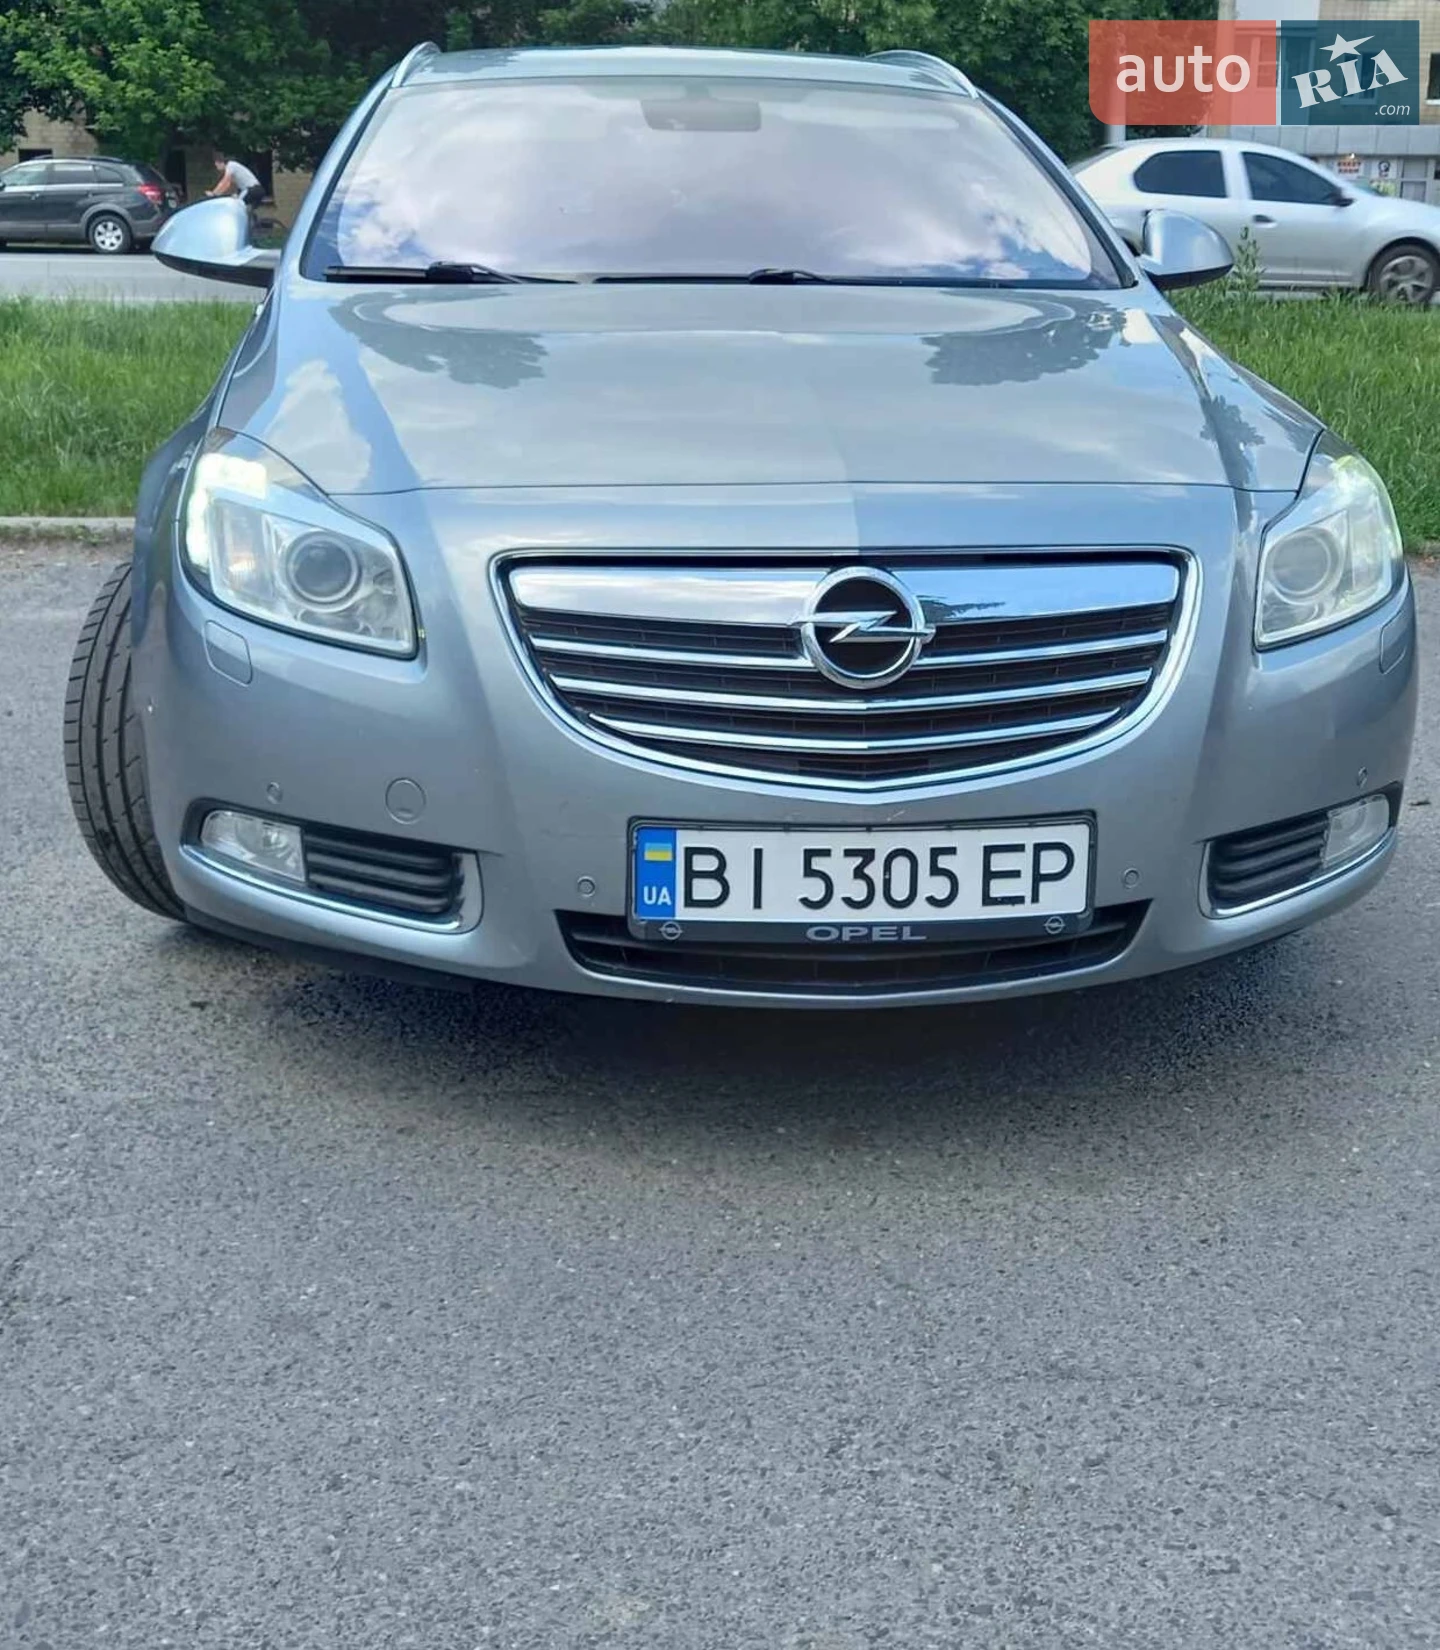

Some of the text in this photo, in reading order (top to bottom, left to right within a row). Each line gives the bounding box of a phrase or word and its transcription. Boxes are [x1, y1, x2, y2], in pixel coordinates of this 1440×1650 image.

[683, 841, 1075, 909] BI 5305 EP
[643, 886, 671, 906] UA
[805, 925, 927, 942] OPEL
